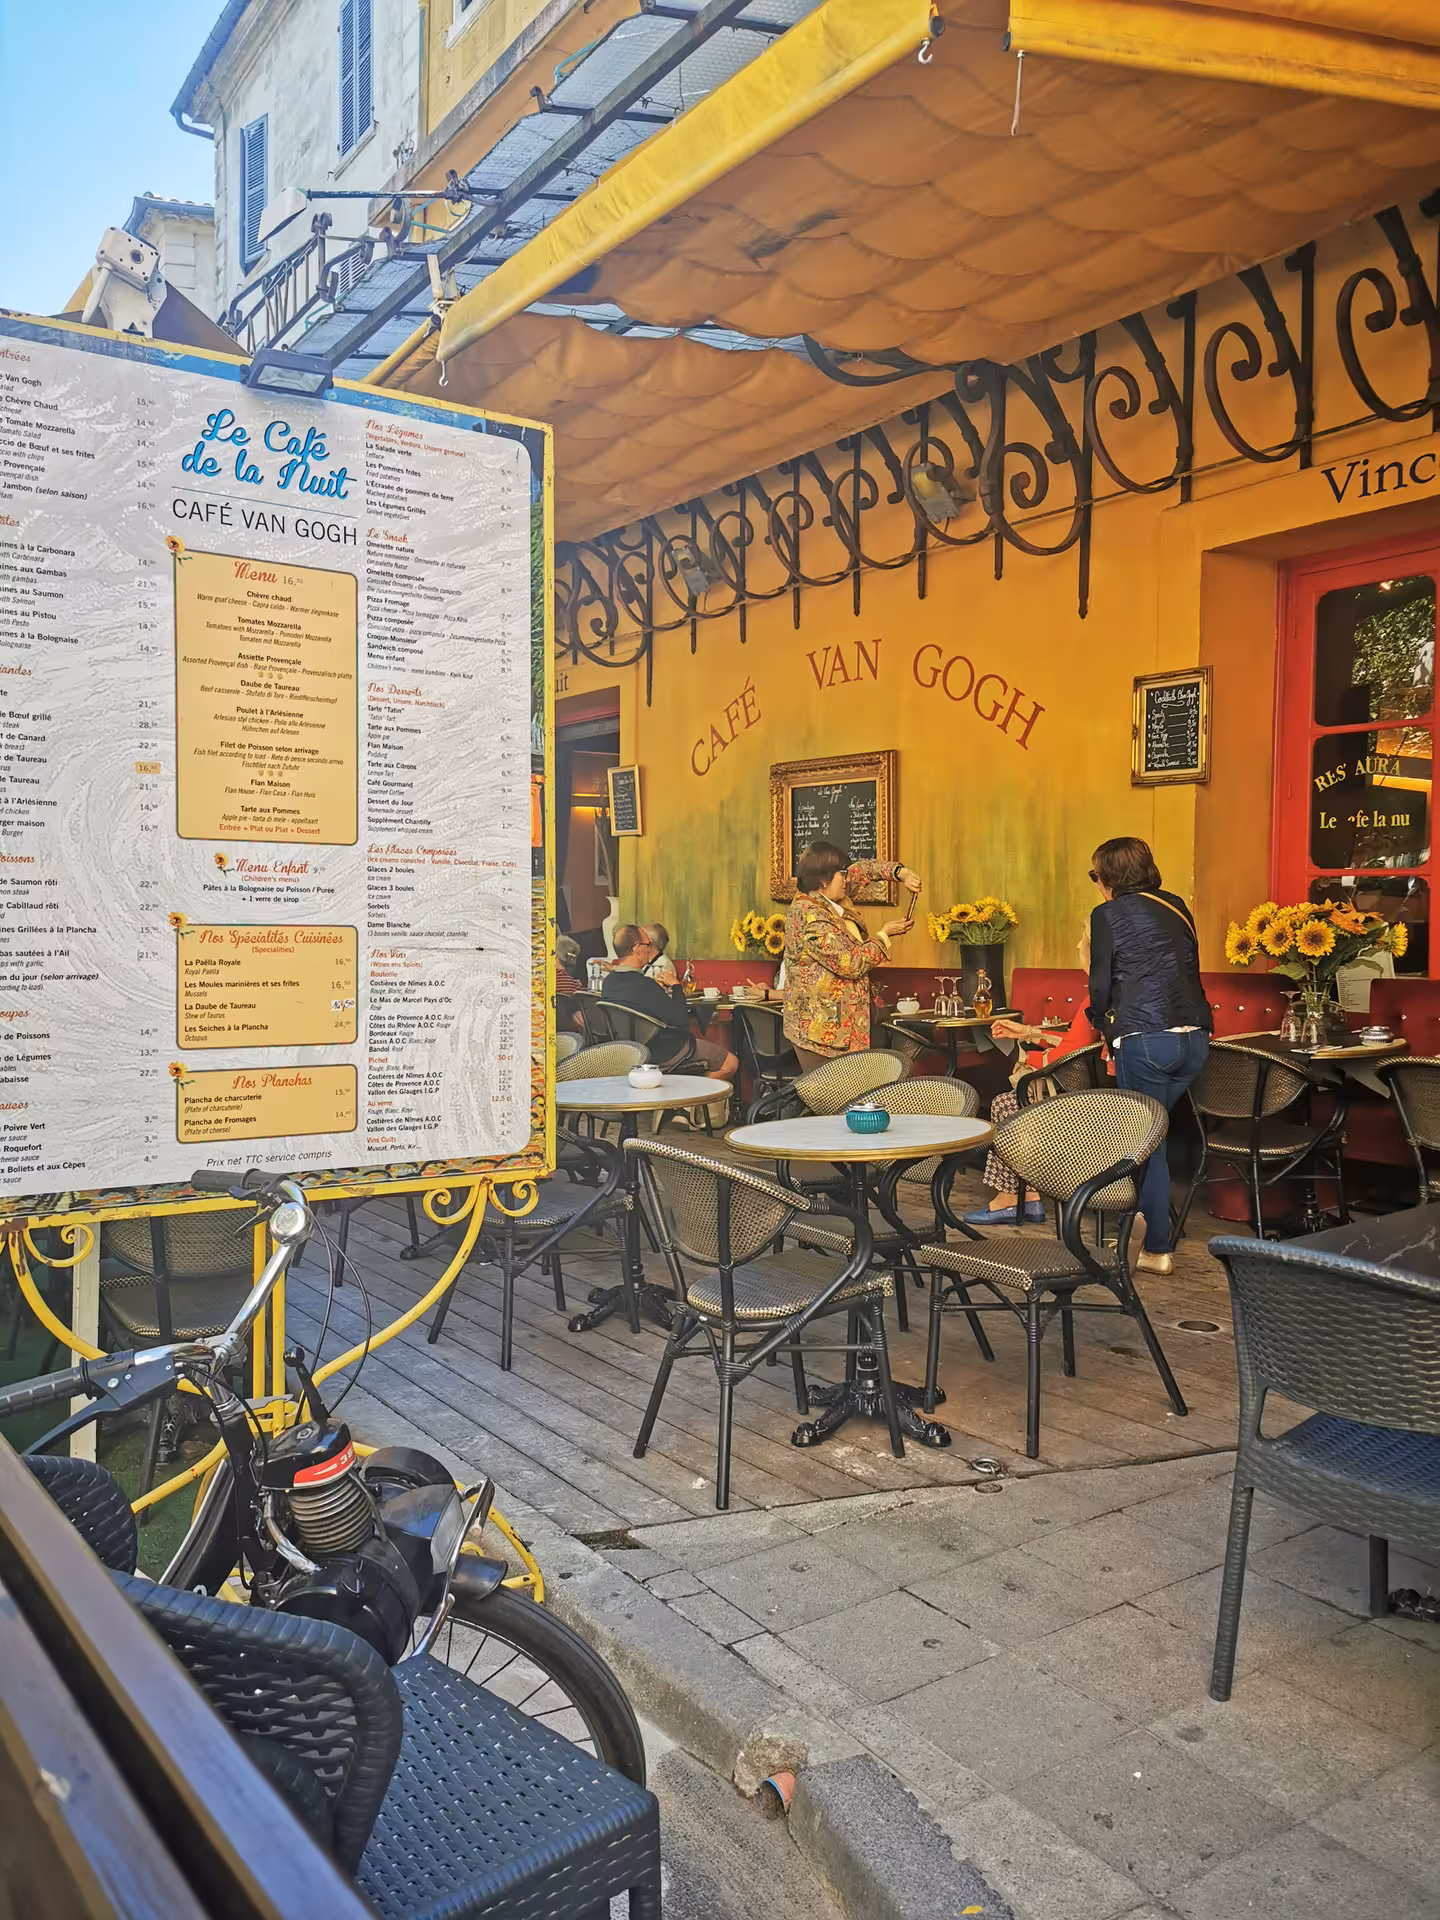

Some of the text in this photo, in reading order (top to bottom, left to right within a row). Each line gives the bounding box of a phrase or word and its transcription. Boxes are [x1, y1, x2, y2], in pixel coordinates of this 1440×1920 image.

[5, 374, 42, 387] Van Gogh
[5, 395, 58, 411] Chèvre Chaud
[6, 417, 76, 435] Tomate Mozzarella
[201, 408, 330, 465] Le Café
[17, 440, 27, 448] de
[76, 450, 96, 460] frites
[4, 460, 46, 473] Provençale
[182, 441, 357, 499] de la Nuit
[3, 482, 88, 501] Jambon (selon saison)
[172, 499, 357, 546] CAFÉ VAN GOGH
[37, 545, 76, 557] Carbonara
[234, 562, 278, 583] Menu
[246, 591, 292, 602] Chèvre chaud
[237, 617, 301, 630] Tomates Mozzarella
[366, 633, 418, 644] Croque-Monsieur
[238, 653, 301, 666] Assiette Provençale
[240, 680, 262, 689] Daube
[274, 683, 300, 692] Taureau
[236, 706, 258, 715] Poulet
[265, 709, 304, 719] l'Arlésienne
[691, 676, 761, 777] CAFÉ
[806, 639, 882, 690] VAN
[913, 644, 1046, 750] GOGH
[18, 734, 46, 742] Canard
[220, 741, 236, 749] Filet
[248, 743, 274, 752] Poisson
[275, 745, 293, 753] selon
[294, 747, 319, 755] arrivage
[16, 755, 47, 764] Taureau
[250, 779, 291, 788] Flan Maison
[367, 779, 414, 788] Café Gourmand
[11, 798, 57, 807] l'Arlésienne
[240, 805, 258, 813] Tarte
[272, 807, 301, 815] Pommes
[17, 820, 45, 828] maison
[367, 816, 431, 826] Supplément Chantilly
[1319, 812, 1337, 829] Le
[1373, 810, 1387, 827] la
[219, 824, 241, 832] Entrée
[250, 825, 263, 833] Plat
[275, 826, 288, 834] Plat
[297, 827, 320, 835] Dessert
[236, 858, 311, 876] Menu Enfant
[10, 878, 58, 886] Saumon rôti
[239, 885, 274, 894] Bolognaise
[283, 895, 299, 904] sirop
[6, 902, 59, 910] Cabillaud rôti
[18, 926, 47, 934] Grillées
[66, 926, 97, 934] Plancha
[199, 929, 343, 949] Nos Spécialités Cuisinées
[252, 946, 295, 954] (Specialities)
[218, 959, 242, 968] Royale
[225, 980, 261, 988] marinières
[282, 979, 300, 987] frites
[230, 1002, 256, 1010] Taureau
[241, 1024, 269, 1032] Plancha
[16, 1032, 51, 1040] Poissons
[16, 1054, 51, 1063] Légumes
[232, 1072, 312, 1089] Nos Planchas
[224, 1094, 262, 1102] charcuterie
[184, 1118, 212, 1126] Plancha
[224, 1116, 257, 1126] Fromages
[30, 1123, 46, 1131] Vert
[4, 1144, 42, 1154] Roquefort
[206, 1150, 332, 1167] Prix net TTC service compris
